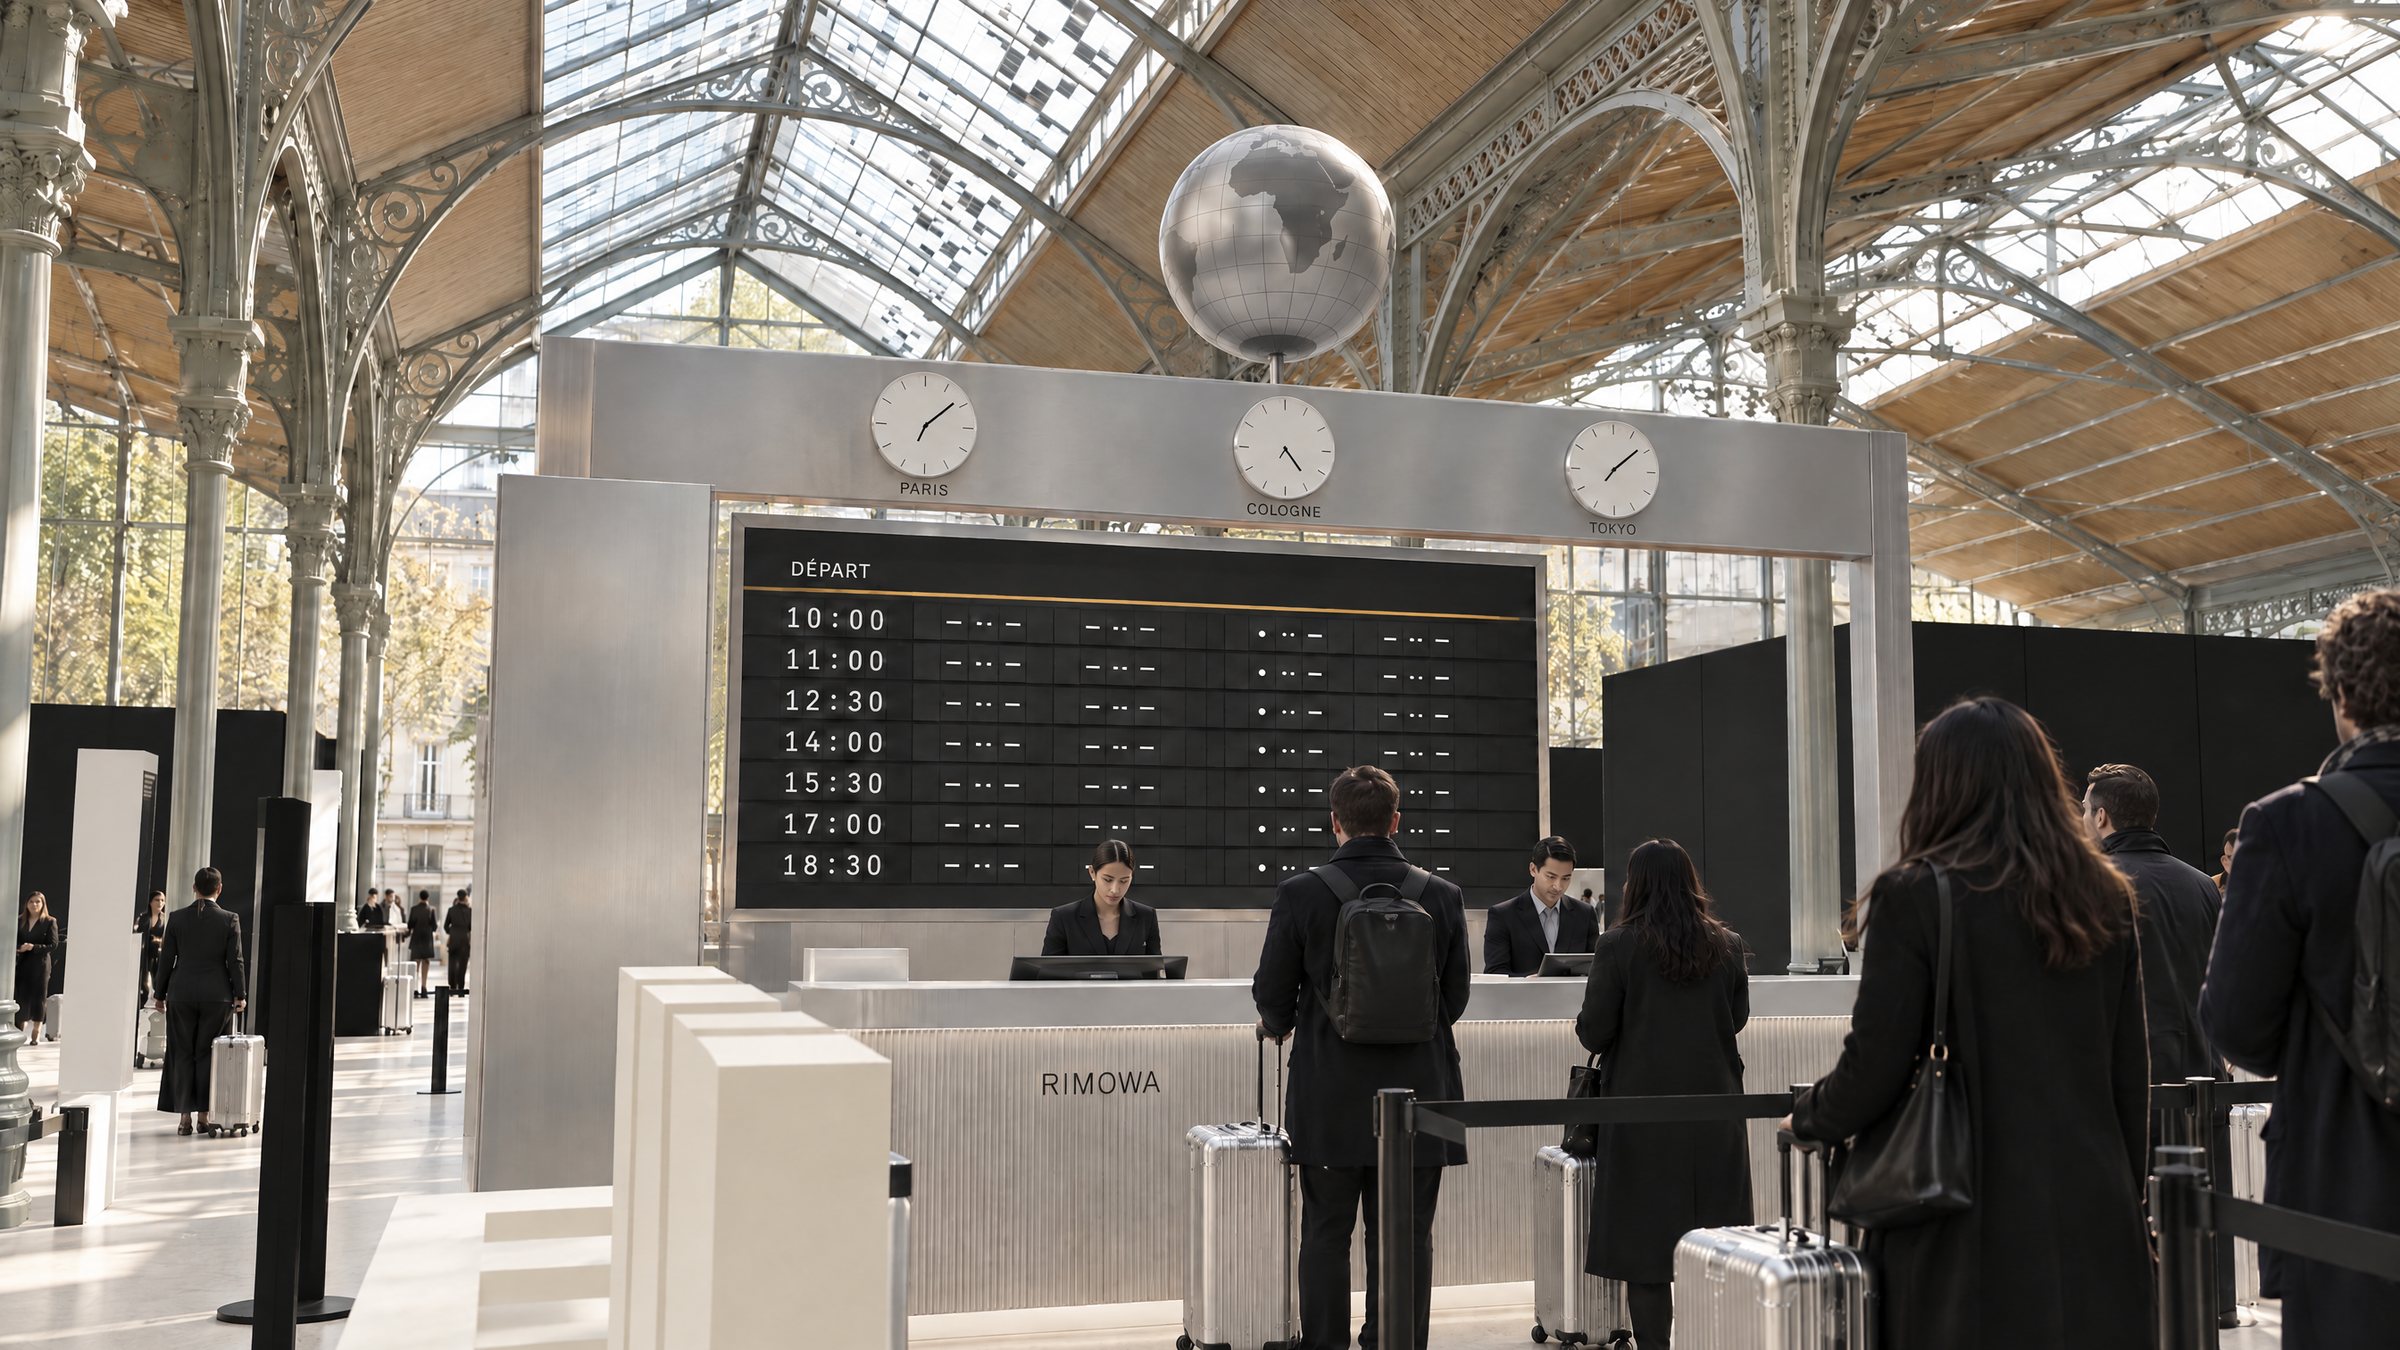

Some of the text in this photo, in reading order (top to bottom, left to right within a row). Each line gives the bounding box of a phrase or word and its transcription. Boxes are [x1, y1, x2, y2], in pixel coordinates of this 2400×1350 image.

[899, 482, 949, 498] PARIS
[1246, 502, 1322, 519] COLOGNE
[1588, 522, 1637, 537] TOKYO
[791, 557, 871, 579] DÉPART
[787, 606, 884, 631] 10:00
[787, 648, 883, 672] 11:00
[786, 689, 883, 712] 12:30
[785, 730, 883, 753] 14:00
[785, 771, 882, 794] 15:30
[784, 812, 882, 835] 17:00
[783, 853, 881, 876] 18:30
[1041, 1070, 1161, 1097] RIMOWA
